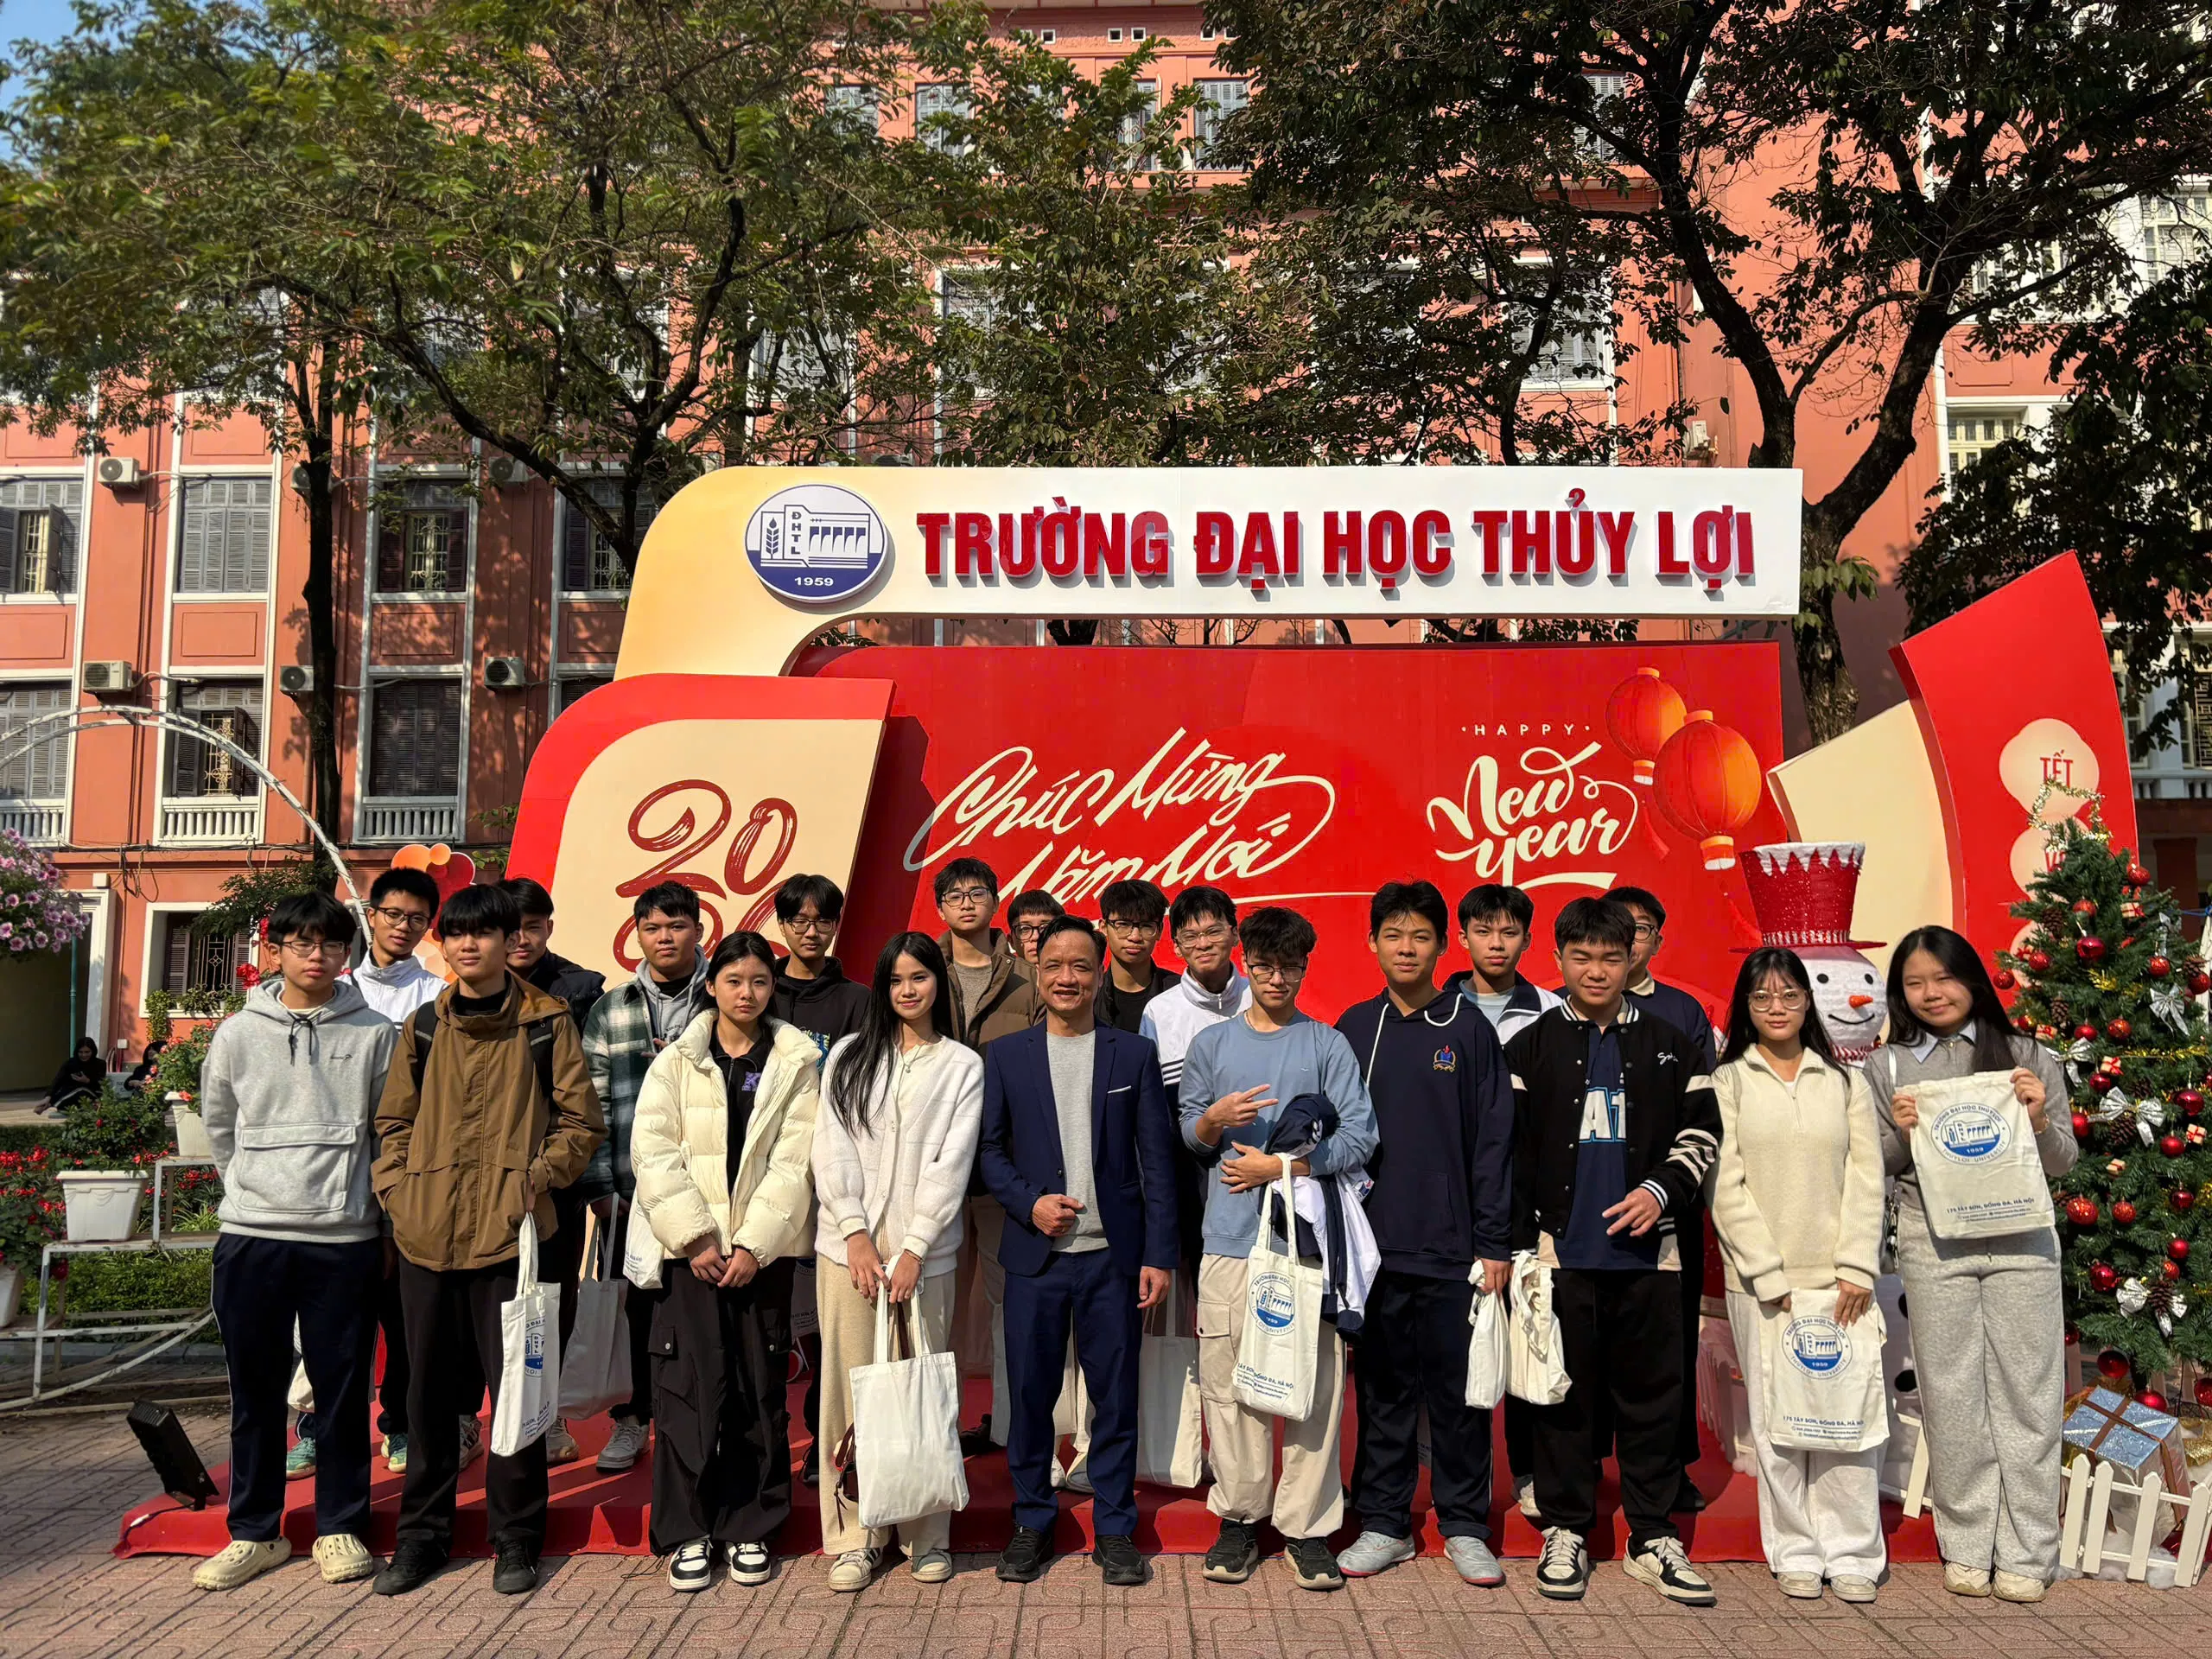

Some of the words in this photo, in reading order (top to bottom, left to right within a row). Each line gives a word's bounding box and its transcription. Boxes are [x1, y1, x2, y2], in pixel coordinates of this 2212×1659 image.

[794, 576, 834, 587] 1959
[916, 496, 1169, 578] TRƯỜNG
[1193, 511, 1300, 590] ĐẠI
[1323, 510, 1452, 590] HỌC
[1473, 487, 1636, 576] THỦY
[1656, 505, 1755, 591] LỢI
[1474, 723, 1574, 735] HAPPY
[2039, 749, 2074, 788] TẾT
[903, 746, 1115, 871] Chúc
[1094, 727, 1300, 826] Mừng
[1427, 741, 1602, 841] New
[614, 779, 798, 900] 20
[1144, 810, 1296, 885] Mới
